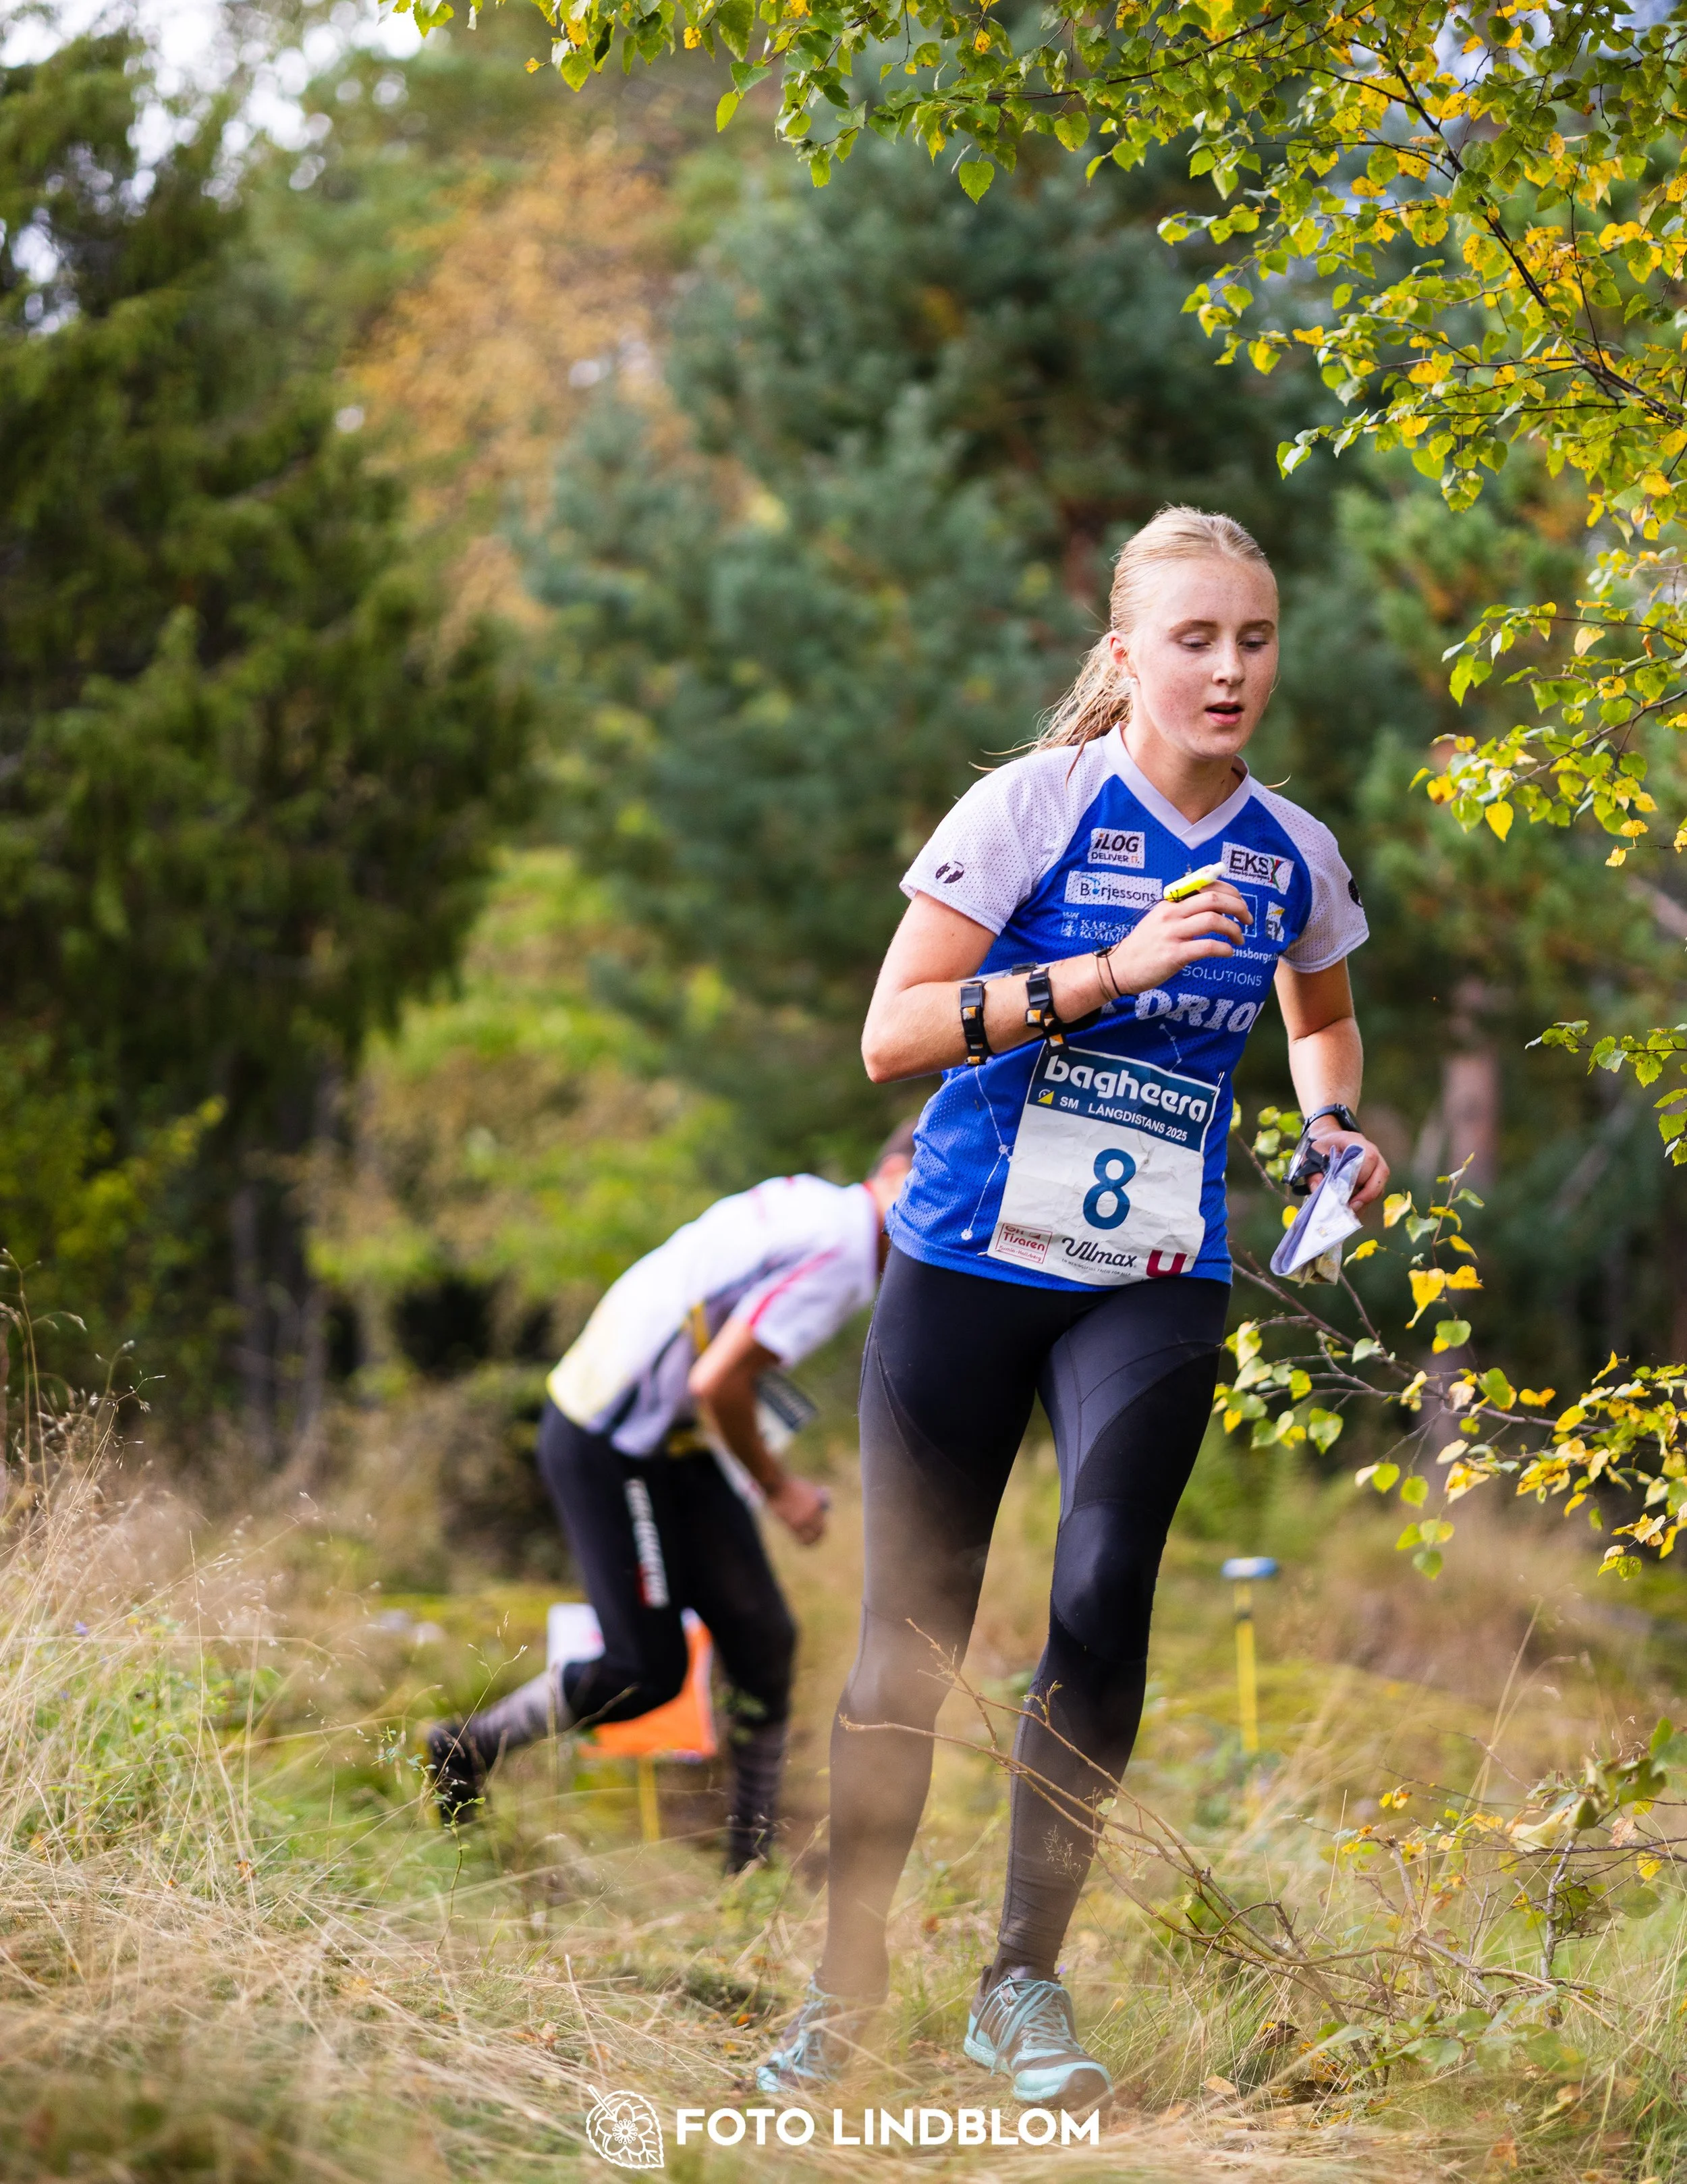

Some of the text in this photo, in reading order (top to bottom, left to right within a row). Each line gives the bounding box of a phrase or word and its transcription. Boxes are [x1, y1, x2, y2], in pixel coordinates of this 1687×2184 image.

[1094, 833, 1140, 852] iLOG
[1091, 852, 1129, 863] DELIVER
[1266, 919, 1281, 939] EY
[1182, 965, 1263, 987] SOLUTIONS
[1135, 988, 1266, 1033] ORIO
[1043, 1054, 1208, 1123] bagheera
[1059, 1096, 1079, 1109] SM
[1165, 1125, 1188, 1142] 2025
[1083, 1147, 1136, 1230] 8
[1003, 1232, 1045, 1251] Tisaren
[1061, 1237, 1138, 1267] Ullmax
